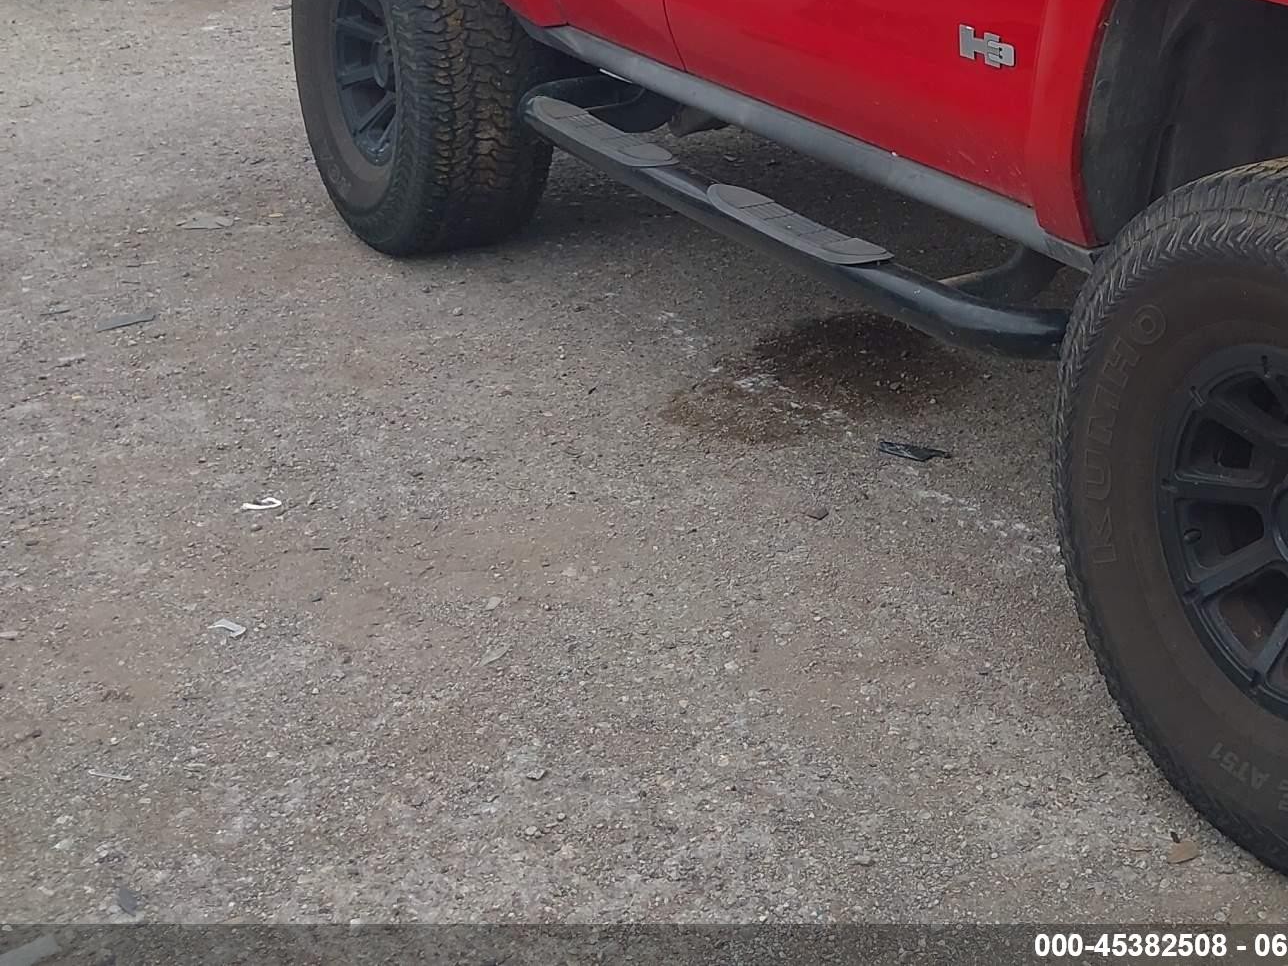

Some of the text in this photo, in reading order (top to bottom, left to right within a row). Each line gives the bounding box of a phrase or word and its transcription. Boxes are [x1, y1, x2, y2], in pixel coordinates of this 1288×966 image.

[959, 24, 1015, 68] H3
[1080, 303, 1168, 565] KUMHO
[1207, 742, 1271, 791] AT51
